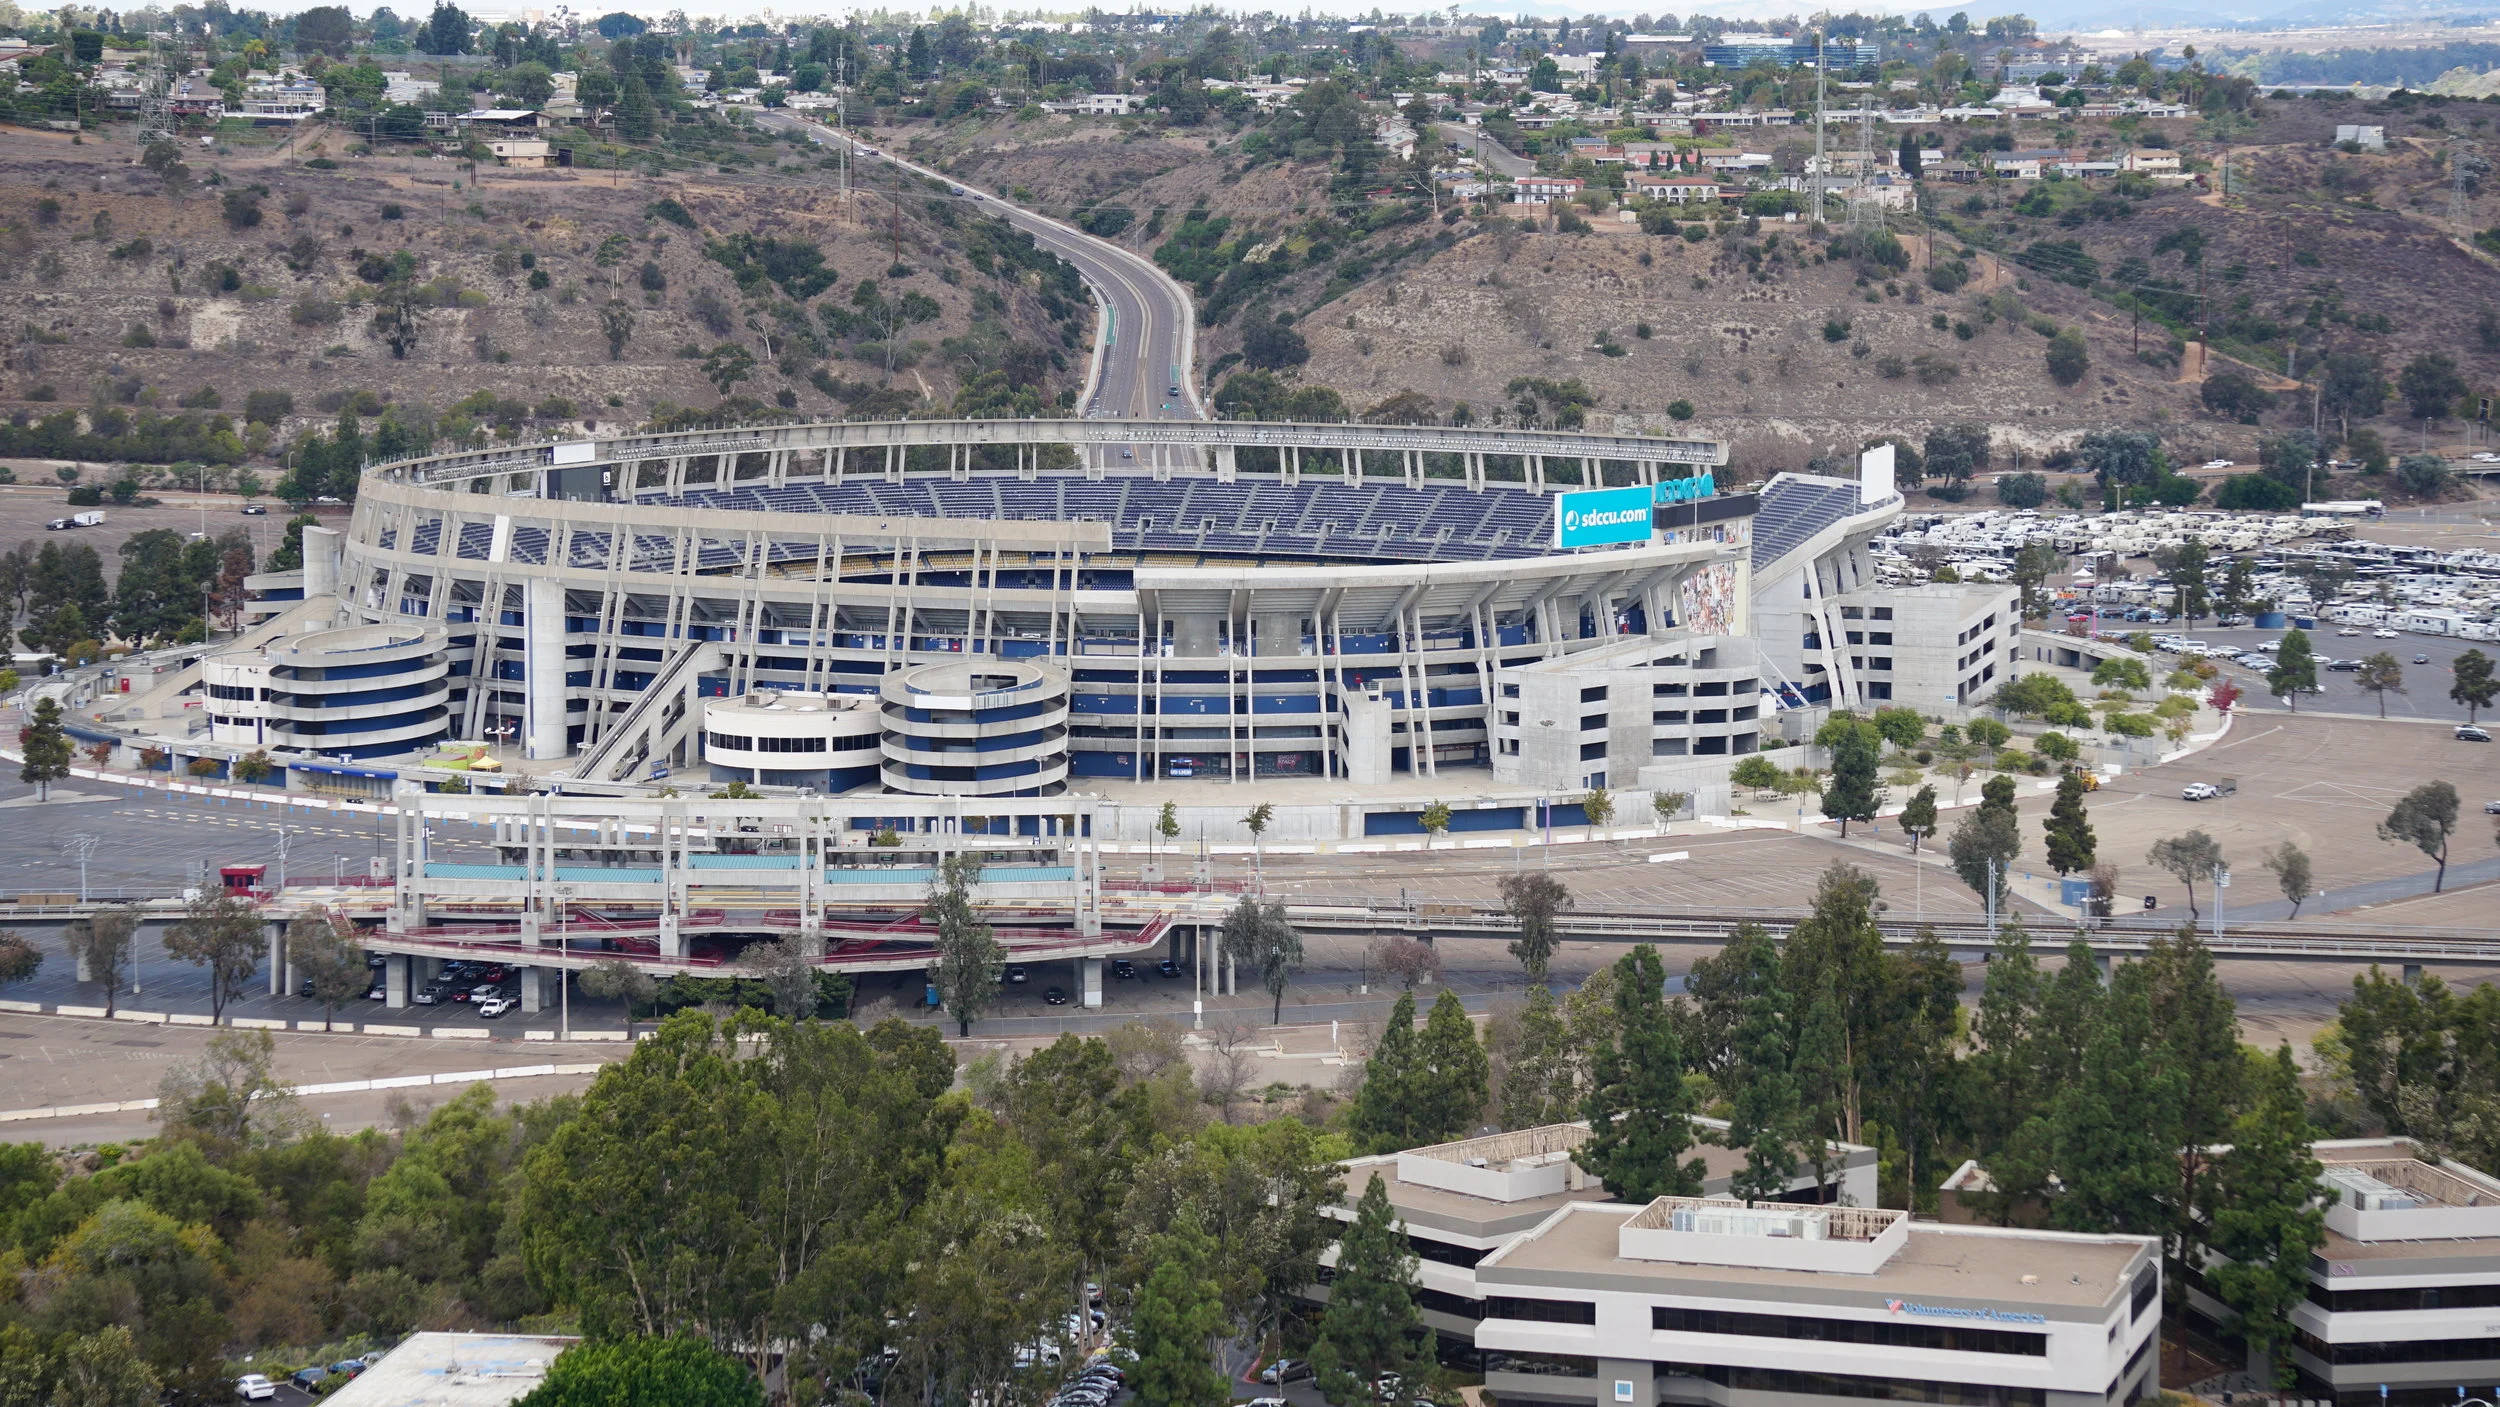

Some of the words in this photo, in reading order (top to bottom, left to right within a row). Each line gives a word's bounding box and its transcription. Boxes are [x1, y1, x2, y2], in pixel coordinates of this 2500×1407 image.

[1581, 508, 1648, 528] sdccu.com
[1902, 1302, 1973, 1319] Volunteers
[1973, 1307, 1990, 1320] of
[1990, 1308, 2046, 1324] America
